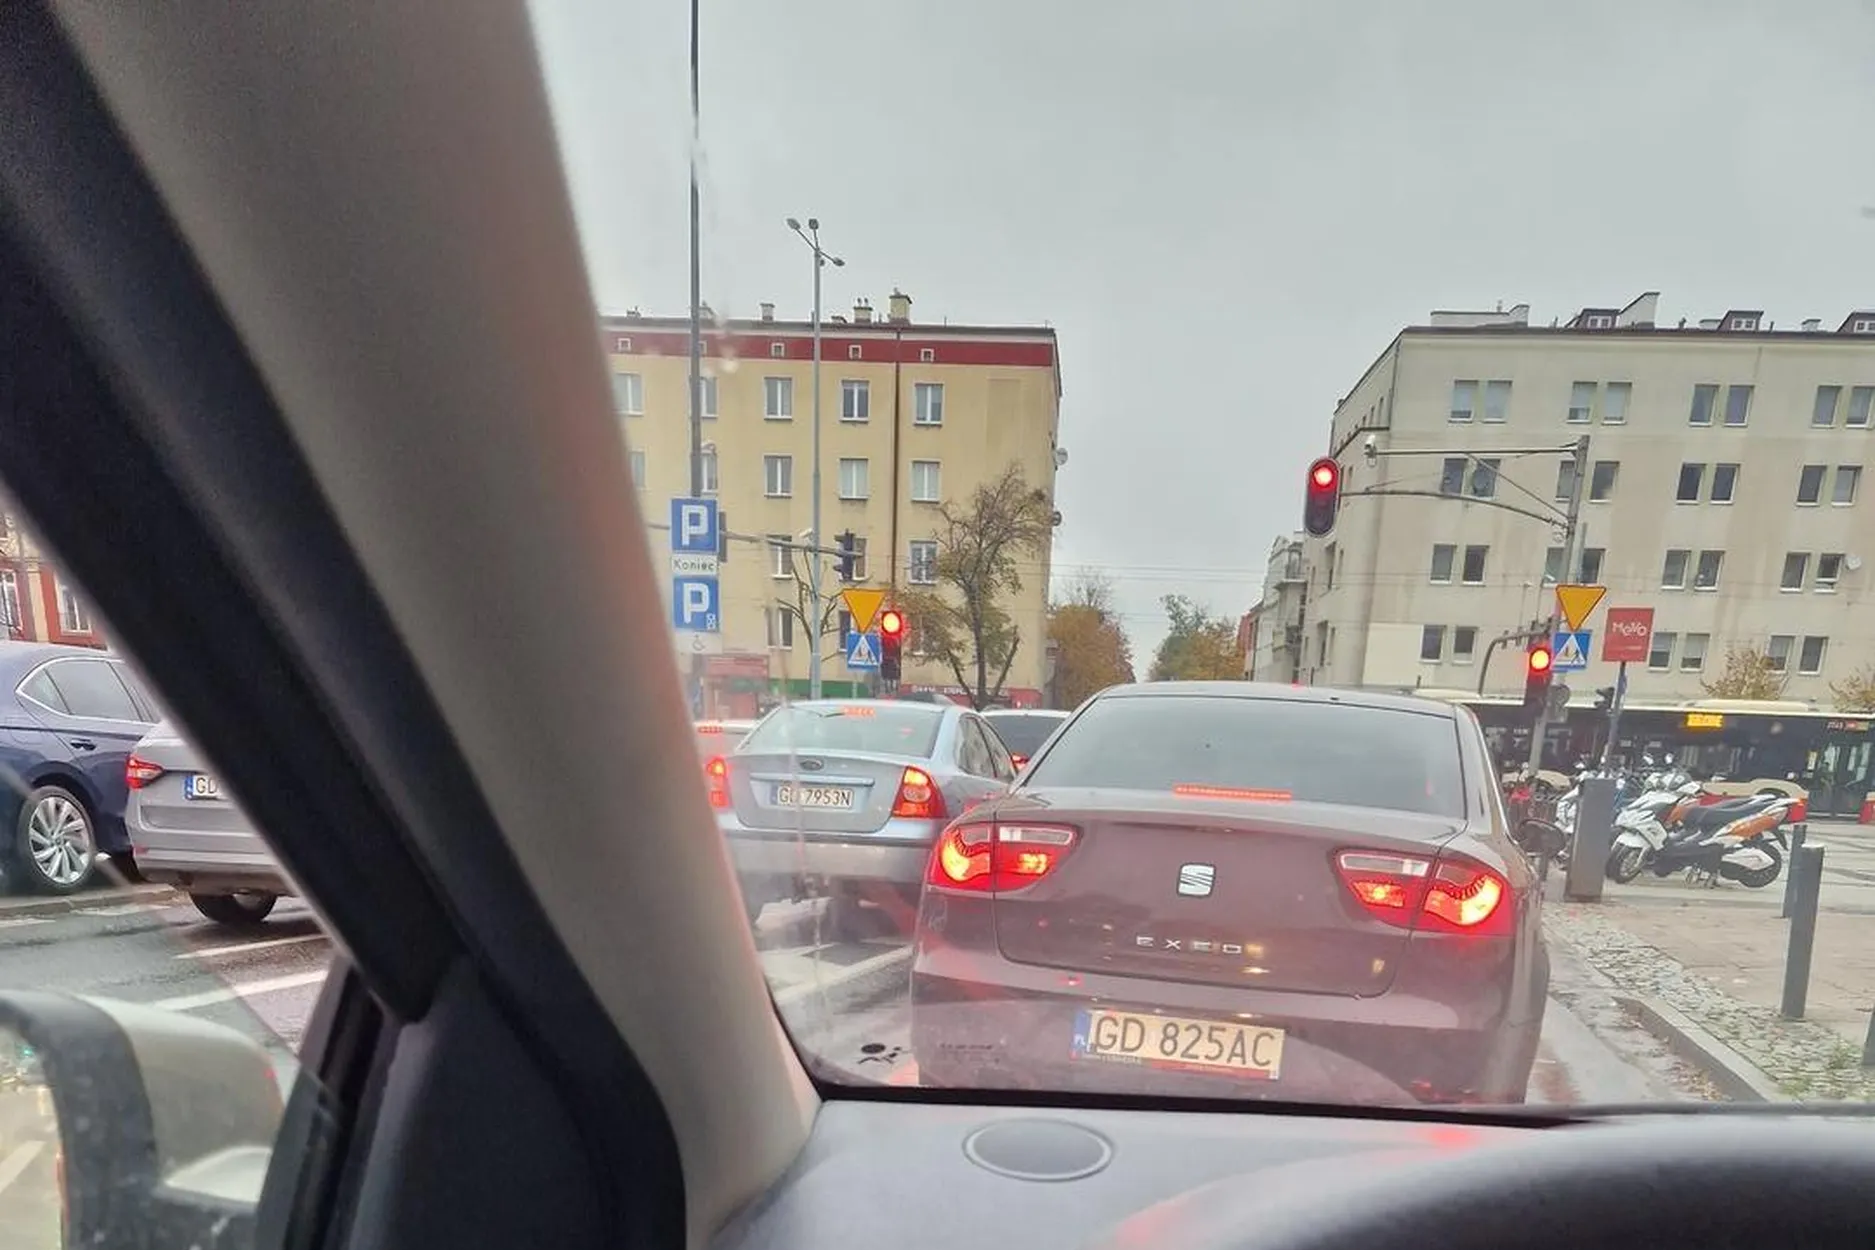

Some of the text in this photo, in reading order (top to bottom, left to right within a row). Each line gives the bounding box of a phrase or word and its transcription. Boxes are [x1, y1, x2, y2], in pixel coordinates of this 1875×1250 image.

[681, 504, 709, 546] P
[673, 560, 715, 572] Koniec
[683, 582, 710, 624] P
[1095, 1016, 1275, 1067] GD 825AC
